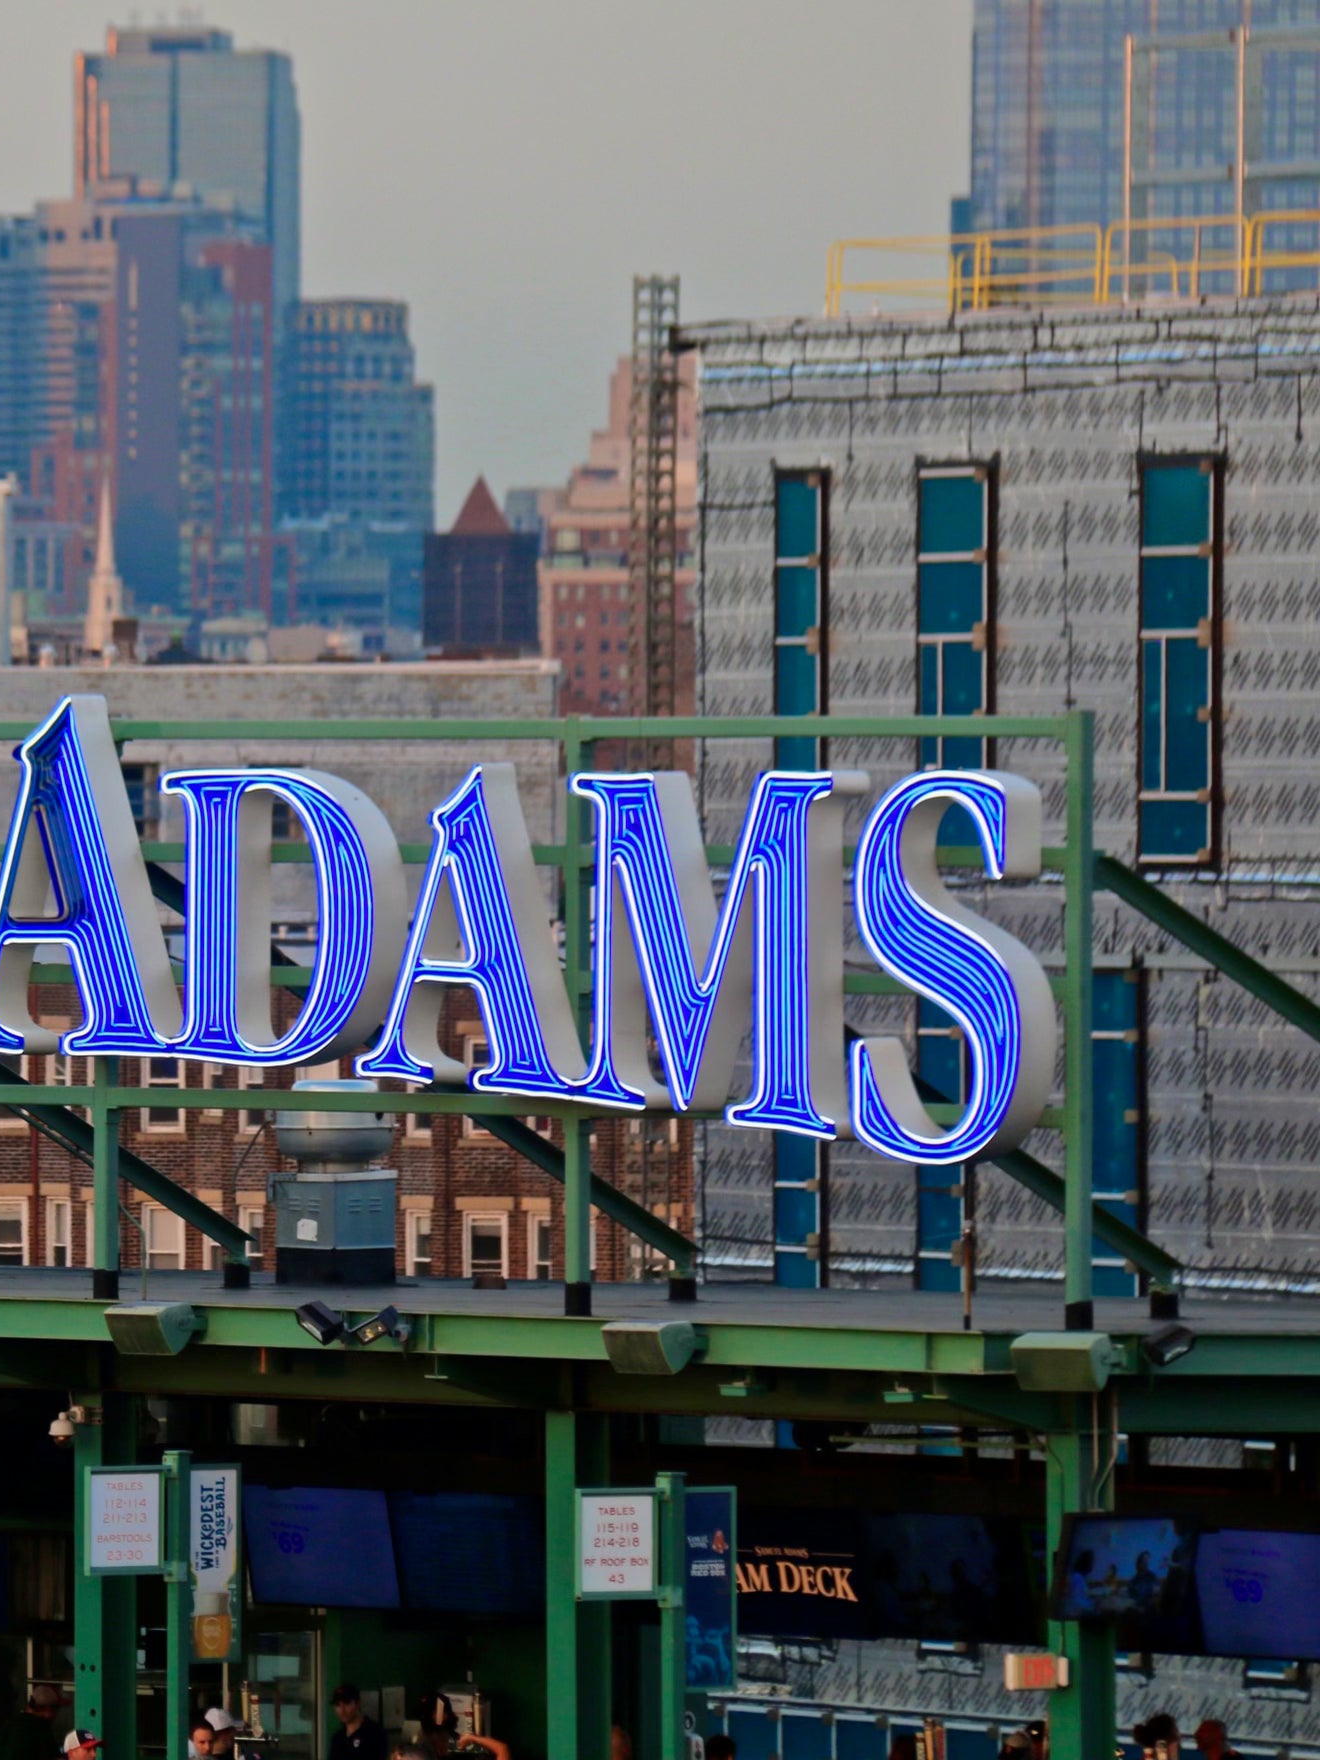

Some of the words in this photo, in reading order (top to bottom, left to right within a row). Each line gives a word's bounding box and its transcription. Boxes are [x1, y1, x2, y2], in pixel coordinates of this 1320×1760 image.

[107, 1482, 144, 1491] TABLES
[104, 1498, 147, 1509] 112-114
[215, 1476, 227, 1551] BASEBALL
[598, 1507, 636, 1516] TABLES
[102, 1513, 148, 1524] 211-213
[596, 1522, 639, 1534] 115-119
[96, 1534, 153, 1543] BARSTOOLS
[593, 1537, 640, 1548] 214-218
[106, 1551, 144, 1561] 23-30
[583, 1558, 596, 1567] RF
[600, 1557, 626, 1567] ROOF
[630, 1557, 649, 1566] BOX
[608, 1574, 625, 1584] 43
[736, 1562, 773, 1593] AM
[776, 1561, 859, 1602] DECK
